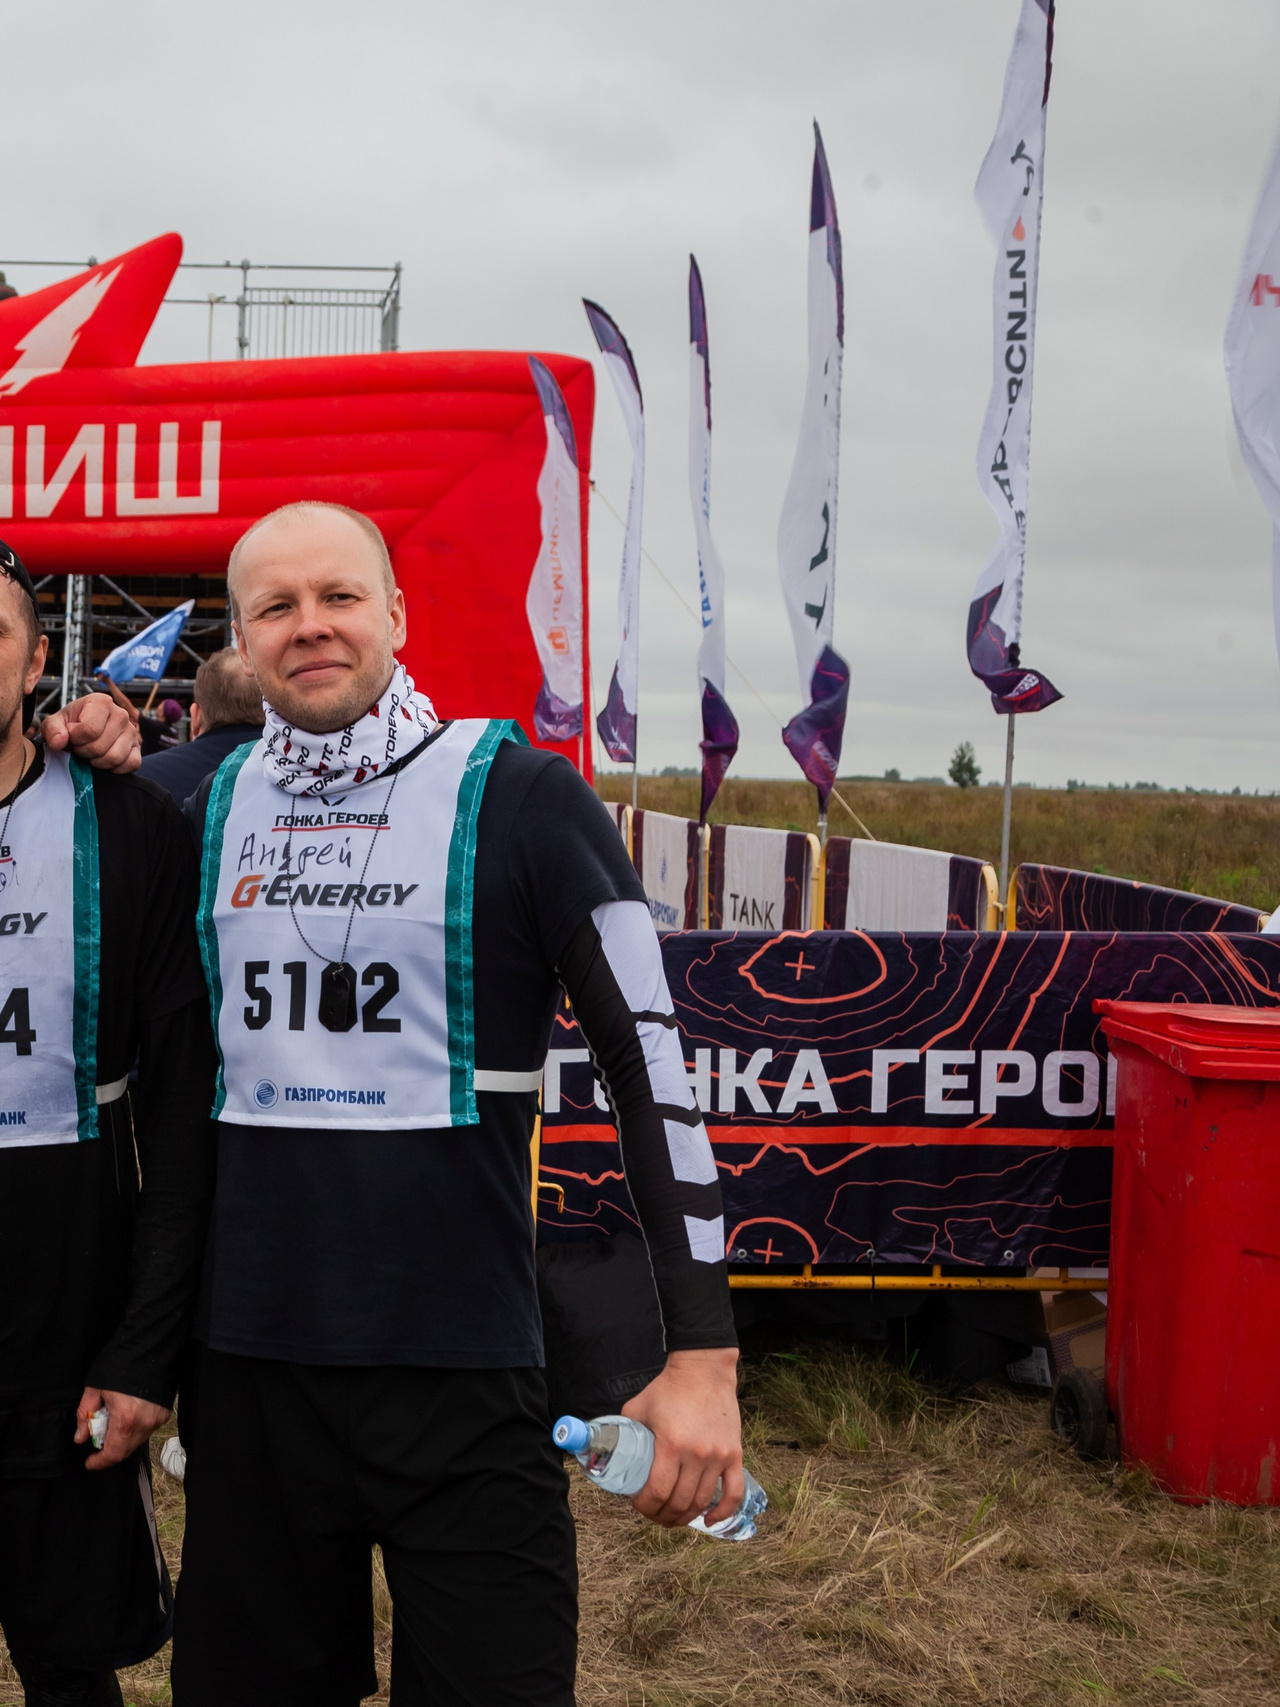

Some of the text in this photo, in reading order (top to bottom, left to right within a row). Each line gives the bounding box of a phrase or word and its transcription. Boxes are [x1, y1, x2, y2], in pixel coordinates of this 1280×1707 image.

[384, 693, 400, 762] TORERO
[274, 811, 389, 827] ГОНКА ГЕРОЕВ
[730, 893, 775, 930] TANK
[284, 1086, 387, 1105] ГАЗПРОМБАНК
[544, 1048, 1116, 1117] ГНКА ГЕРО
